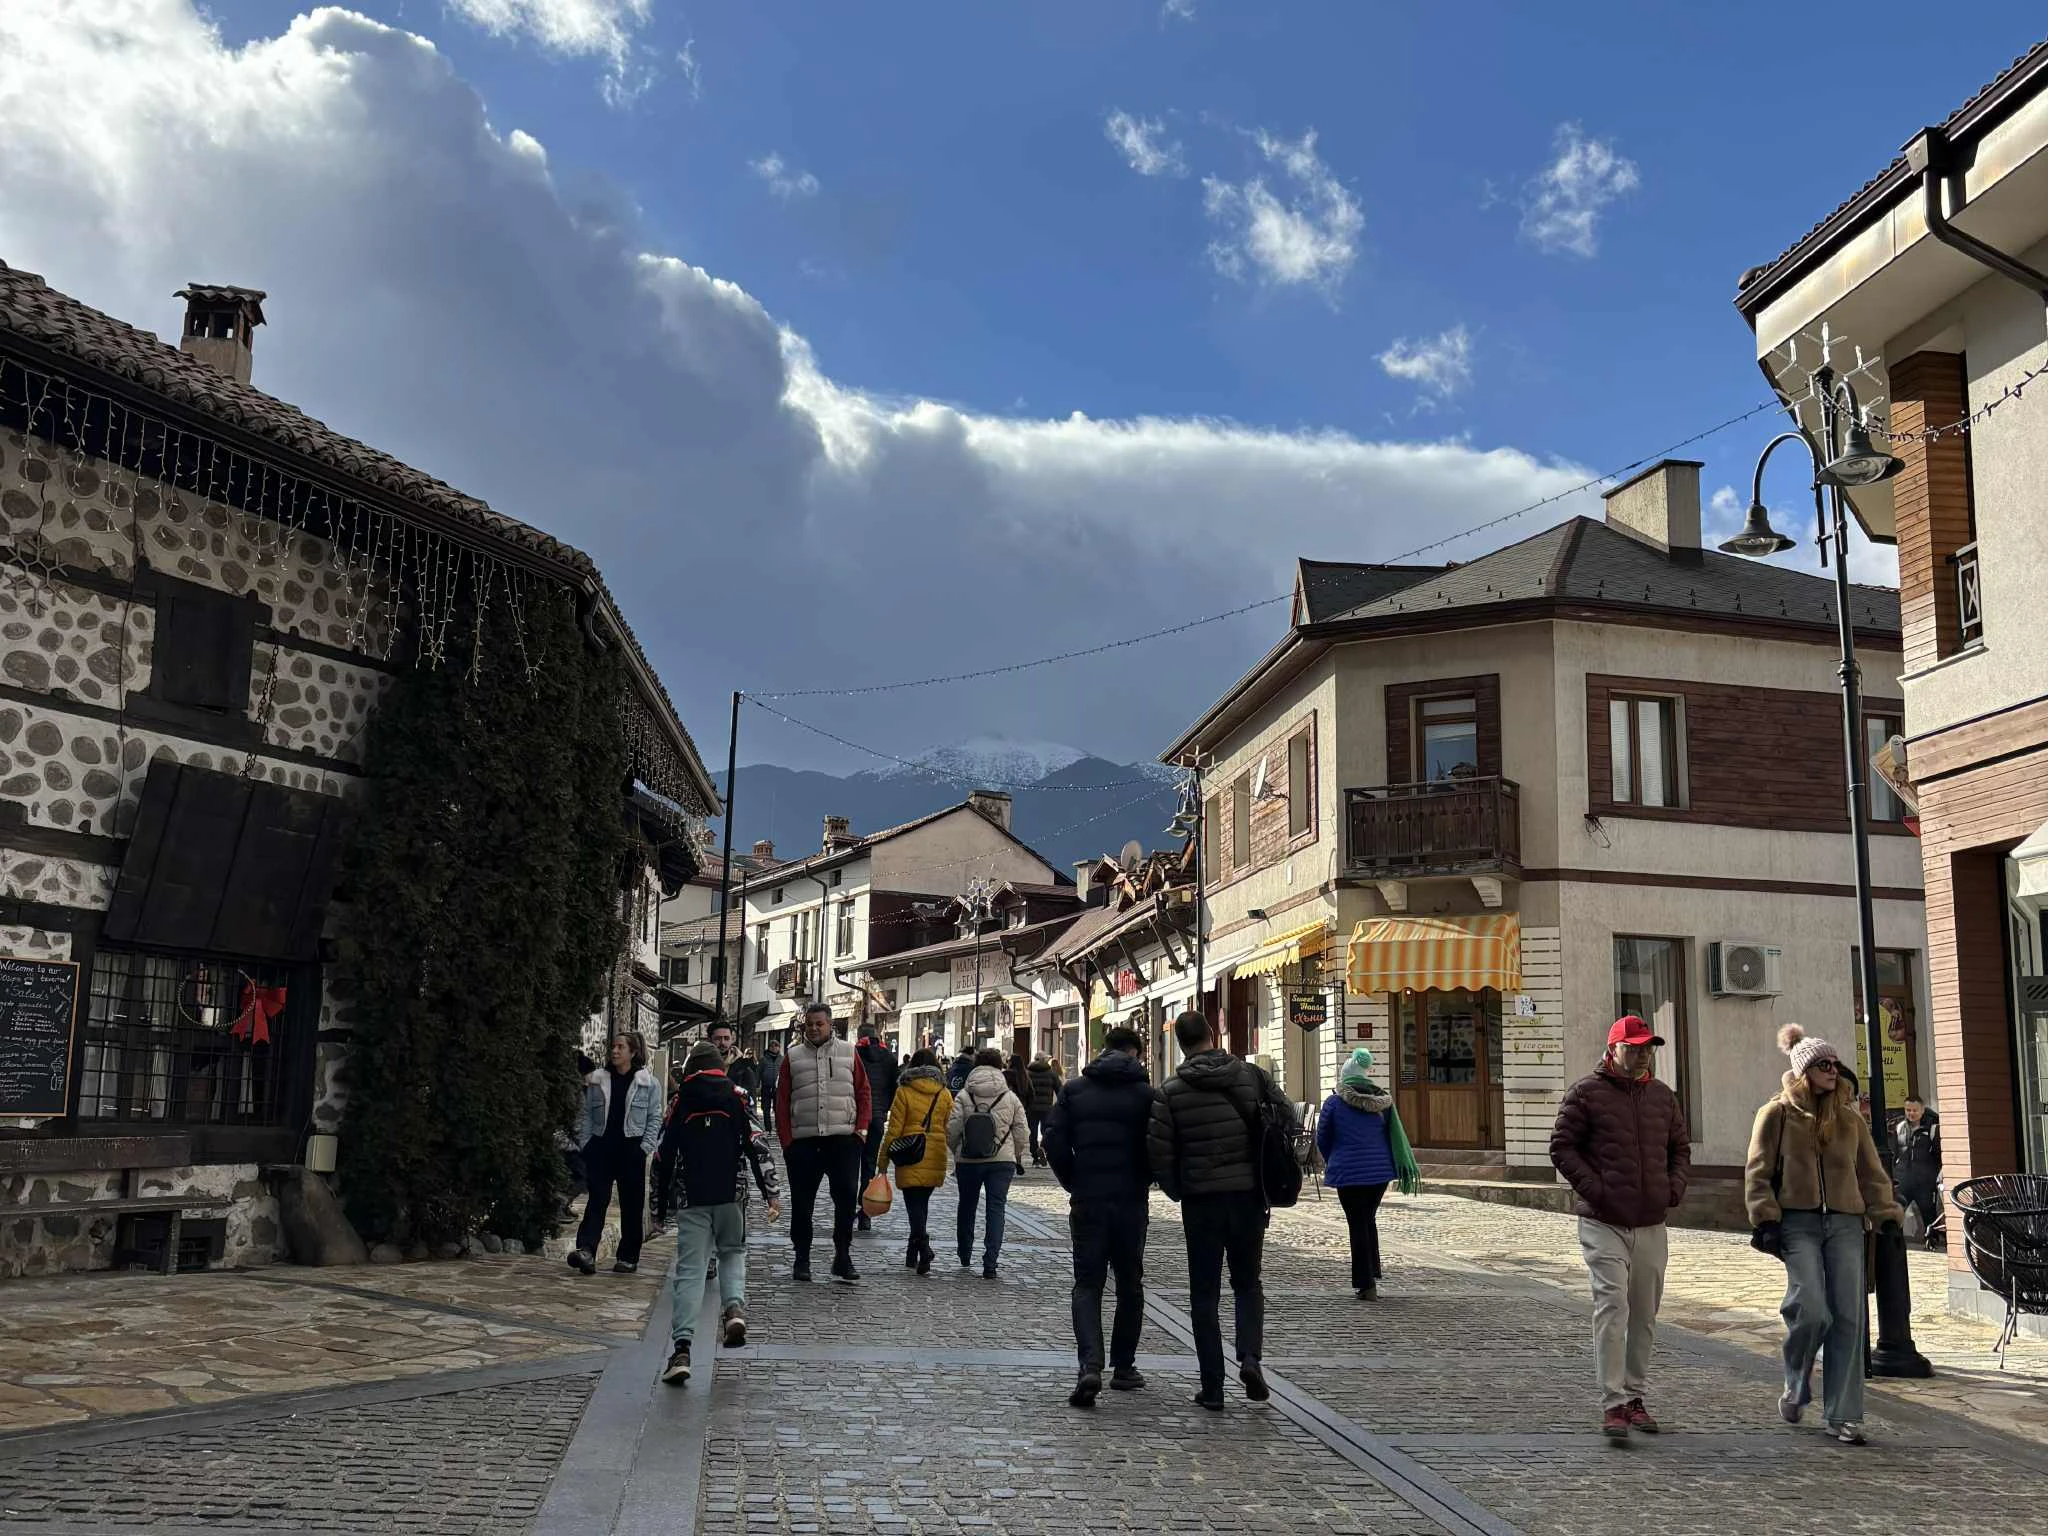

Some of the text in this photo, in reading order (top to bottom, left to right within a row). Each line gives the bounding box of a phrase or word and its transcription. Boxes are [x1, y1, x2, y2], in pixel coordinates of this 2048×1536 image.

[37, 964, 46, 973] to
[1291, 994, 1315, 1003] Sweet
[1300, 1002, 1325, 1011] House
